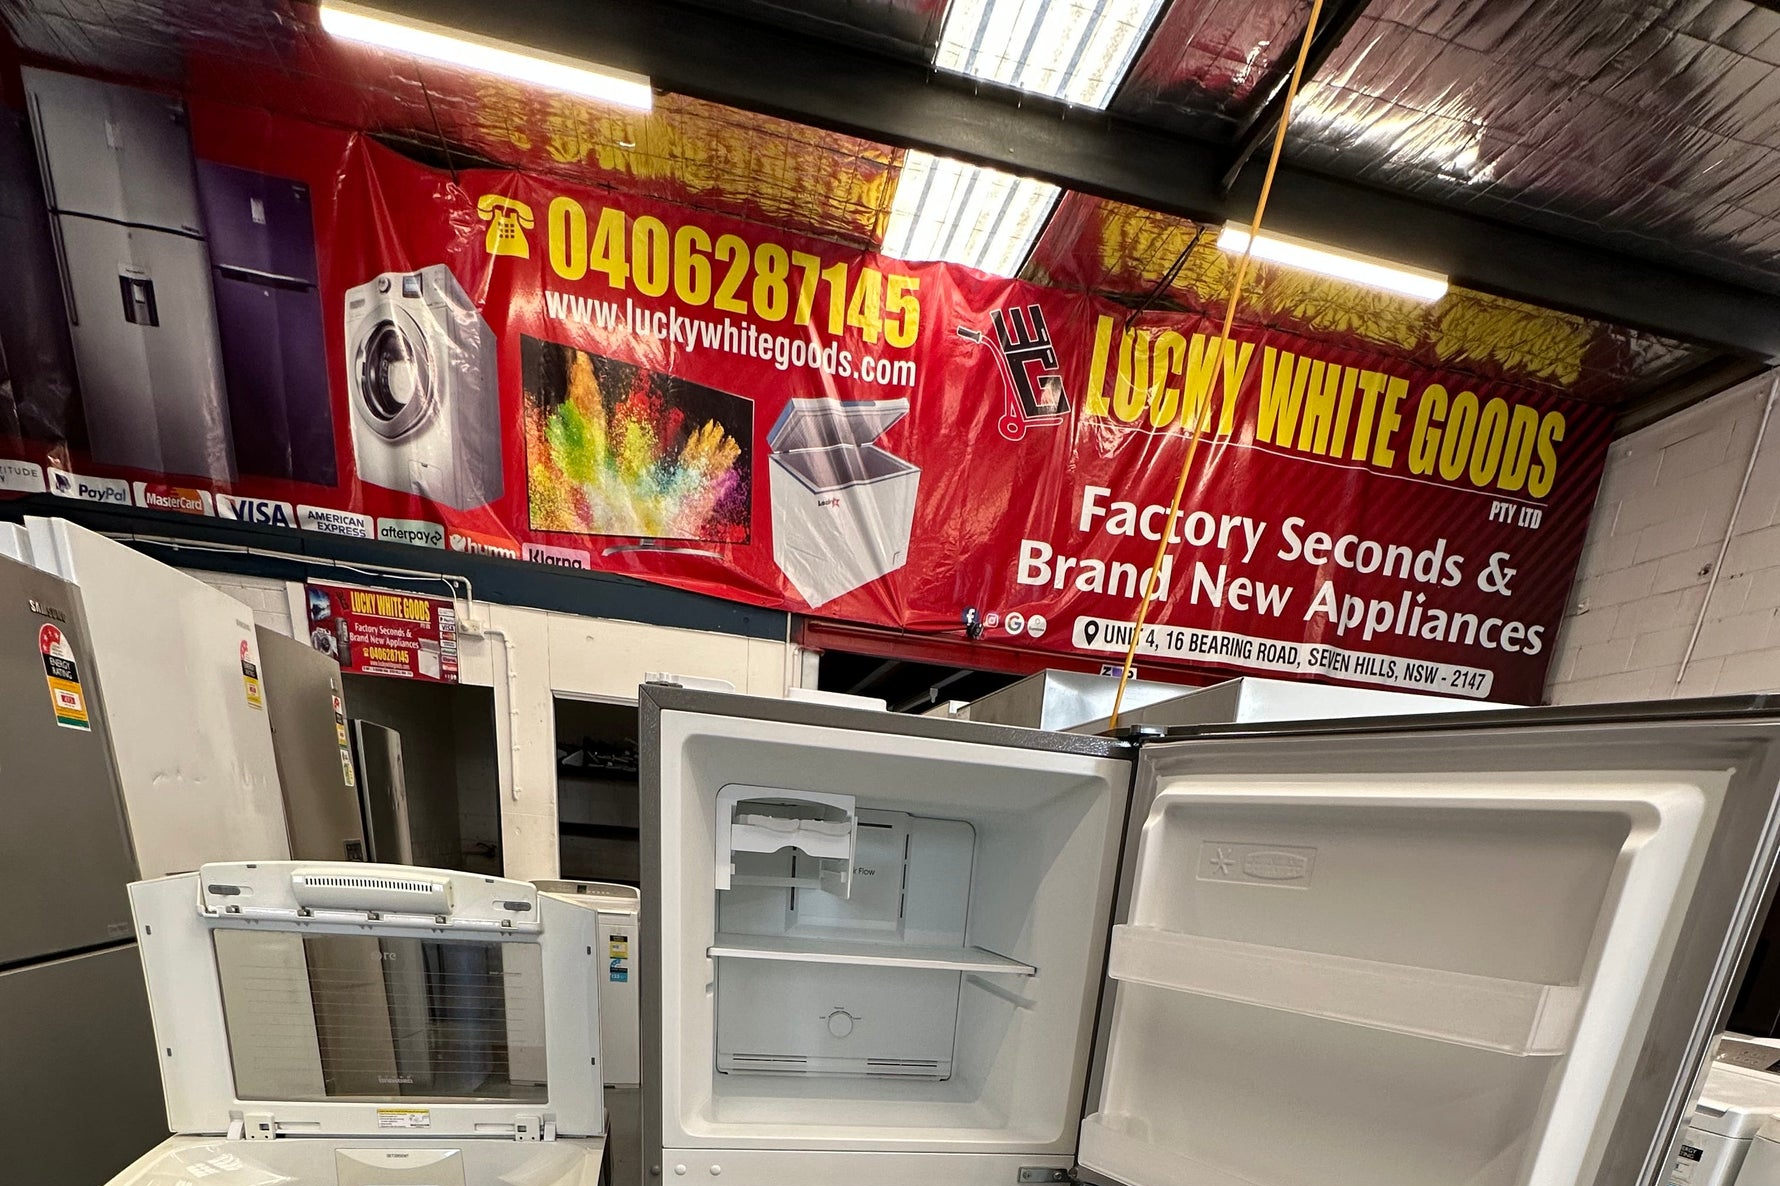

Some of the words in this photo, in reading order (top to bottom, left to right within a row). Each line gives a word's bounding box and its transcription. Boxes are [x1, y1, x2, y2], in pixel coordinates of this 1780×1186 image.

[548, 196, 921, 348] 0406287145
[545, 290, 917, 387] www.luckywhitegoods.com
[1085, 314, 1256, 436] LUCKY
[1256, 345, 1410, 469] WHITE
[1408, 383, 1566, 499] GOODS
[78, 483, 127, 502] PayPal
[146, 491, 203, 511] MasterCard
[231, 499, 290, 529] VISA
[307, 510, 364, 528] AMERICAN
[1488, 500, 1515, 524] PTY
[1517, 507, 1543, 530] LTD
[317, 521, 366, 538] EXPRESS
[380, 526, 431, 544] afterpay
[1079, 484, 1268, 564] Factory
[1277, 516, 1465, 588] Seconds
[1476, 551, 1518, 597] &
[350, 591, 376, 614] LUCKY
[376, 594, 403, 618] WHITE
[403, 598, 430, 622] GOODS
[1016, 538, 1174, 603] Brand
[1190, 560, 1295, 618] New
[1303, 580, 1546, 656] Appliances
[349, 632, 369, 643] Brand
[370, 634, 385, 645] New
[385, 637, 419, 649] Appliances
[354, 622, 378, 635] Factory
[379, 625, 405, 637] Seconds
[405, 629, 412, 638] &
[1145, 629, 1159, 651] 4,
[1166, 630, 1185, 650] 16
[1189, 633, 1252, 660] BEARING
[1256, 642, 1301, 669] ROAD,
[1307, 647, 1351, 673] SEVEN
[1353, 655, 1399, 682] HILLS,
[1403, 663, 1439, 684] NSW
[1450, 669, 1486, 691] 2147
